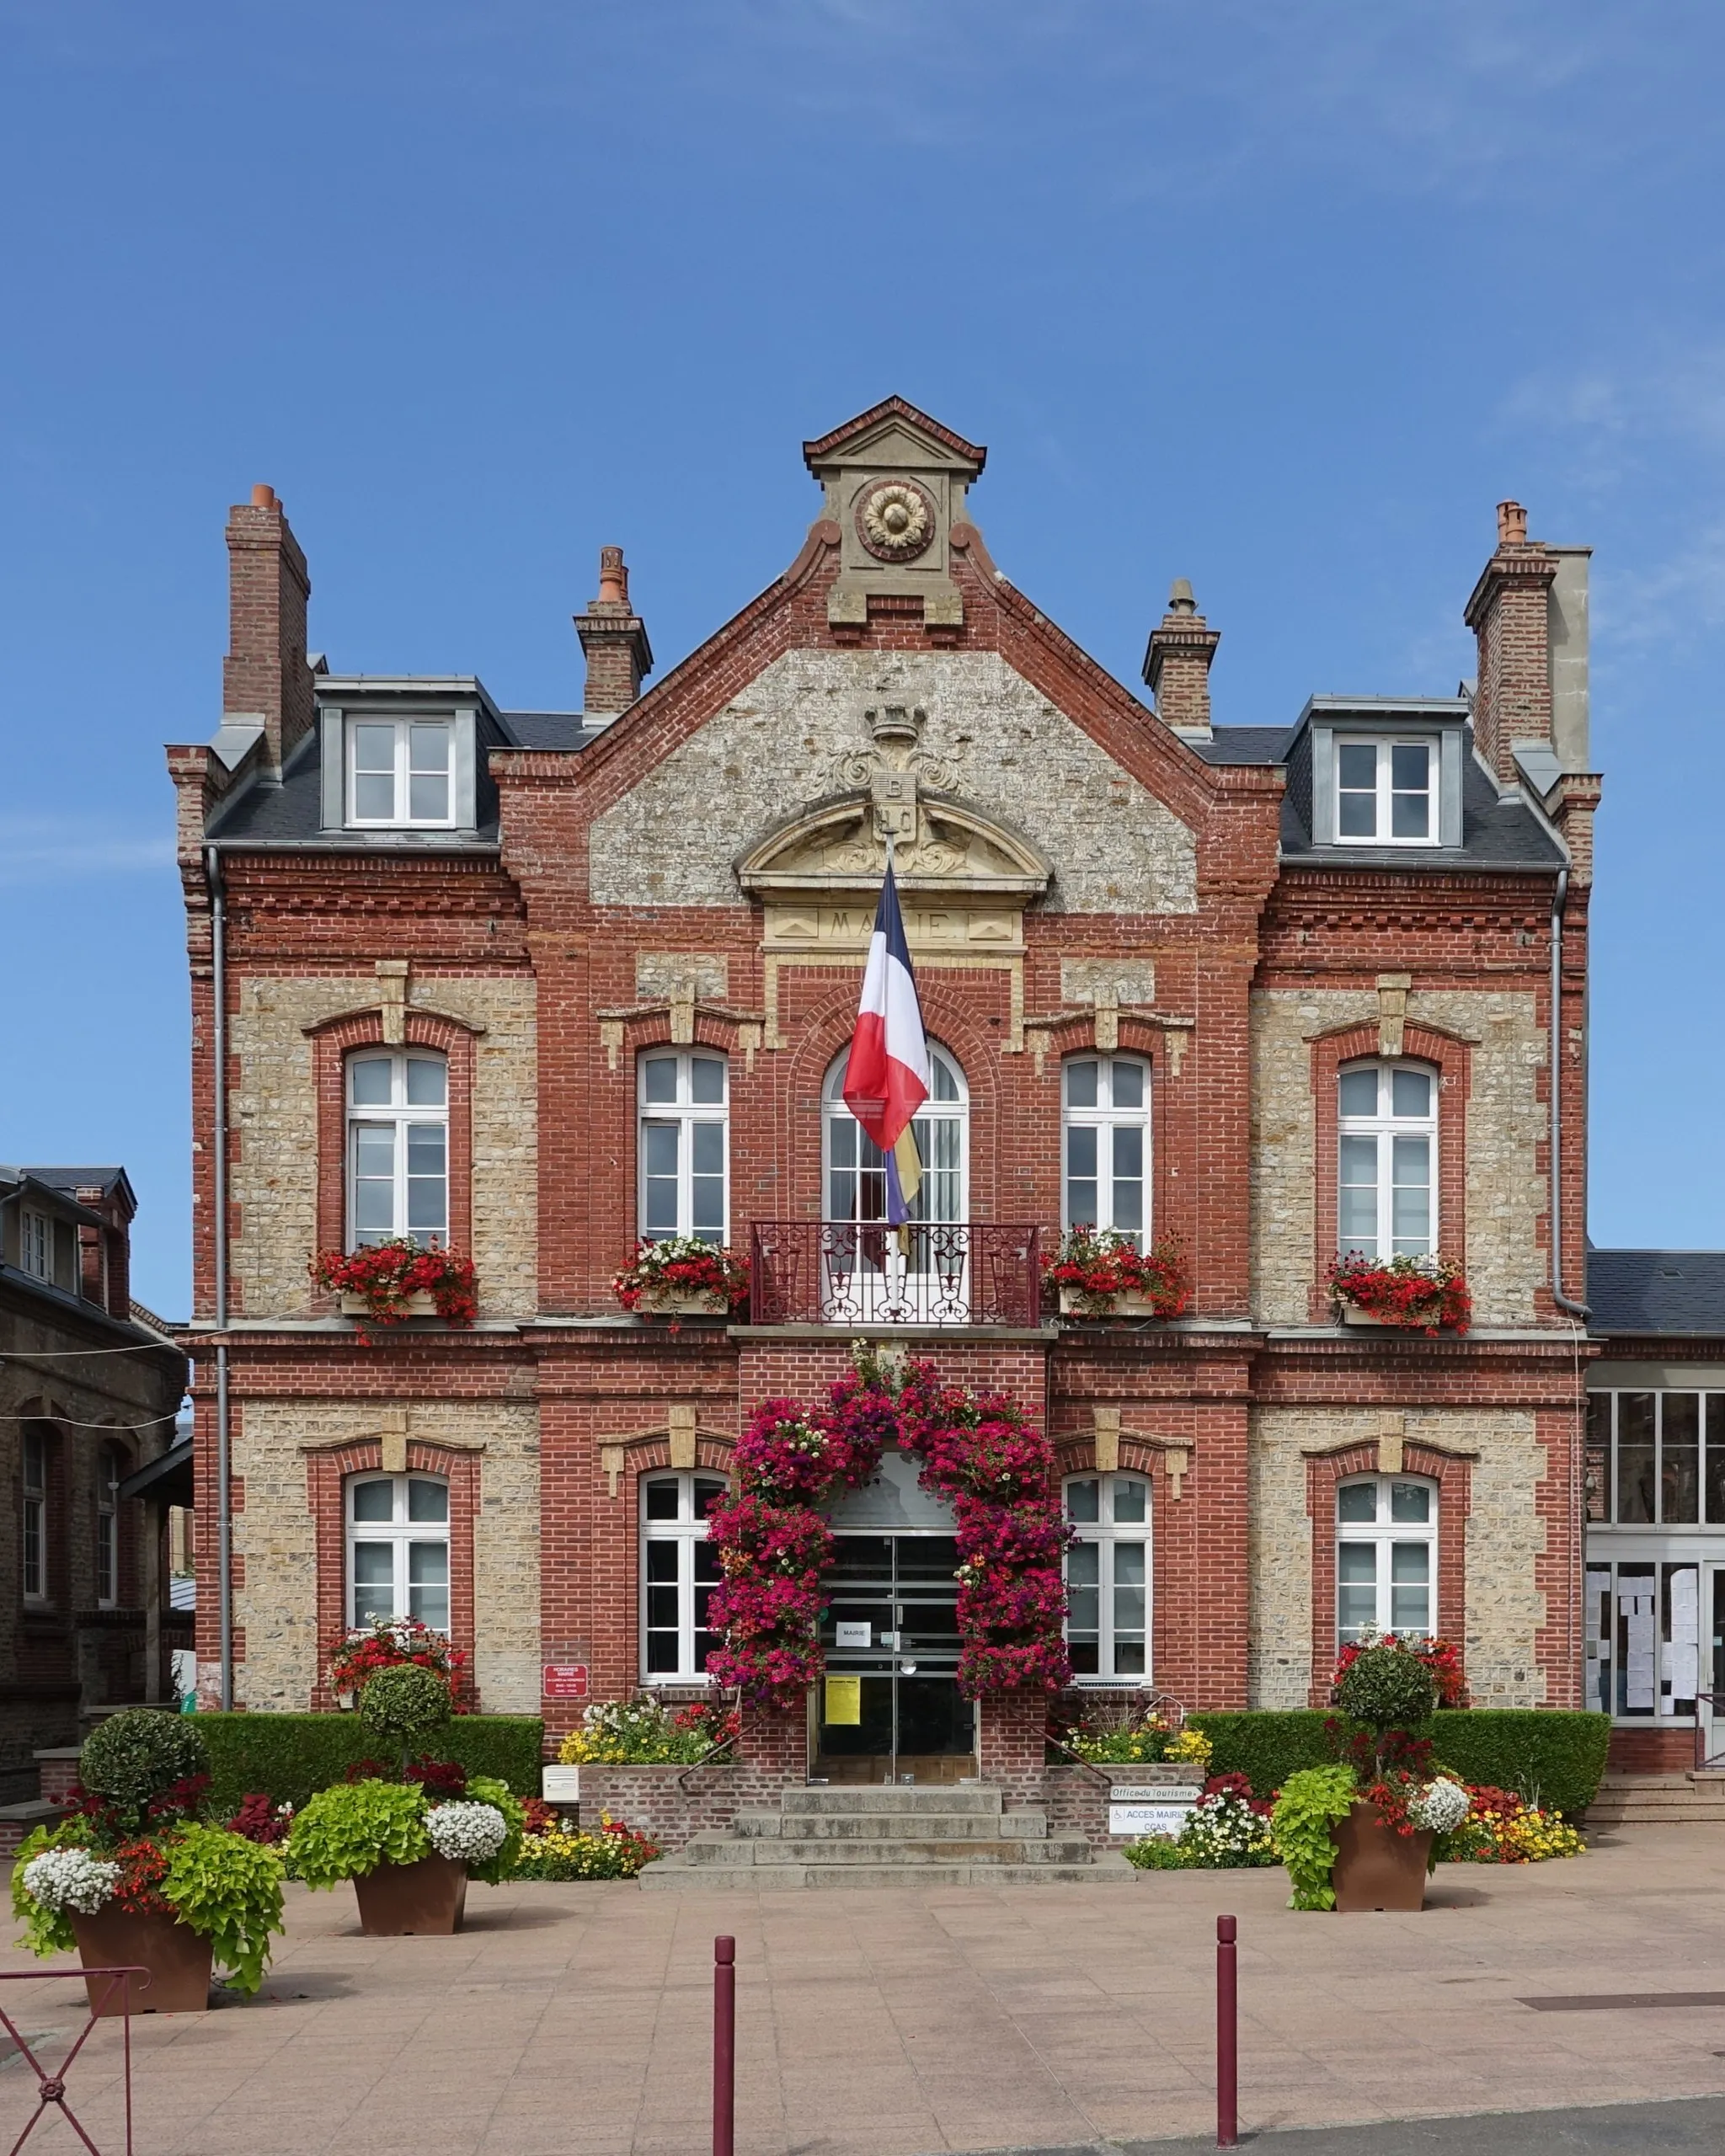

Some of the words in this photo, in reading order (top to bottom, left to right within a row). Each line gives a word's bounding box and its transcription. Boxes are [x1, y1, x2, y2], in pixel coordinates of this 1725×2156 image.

[1113, 1788, 1140, 1796] Office
[1141, 1788, 1151, 1796] du
[1126, 1810, 1154, 1818] ACCES
